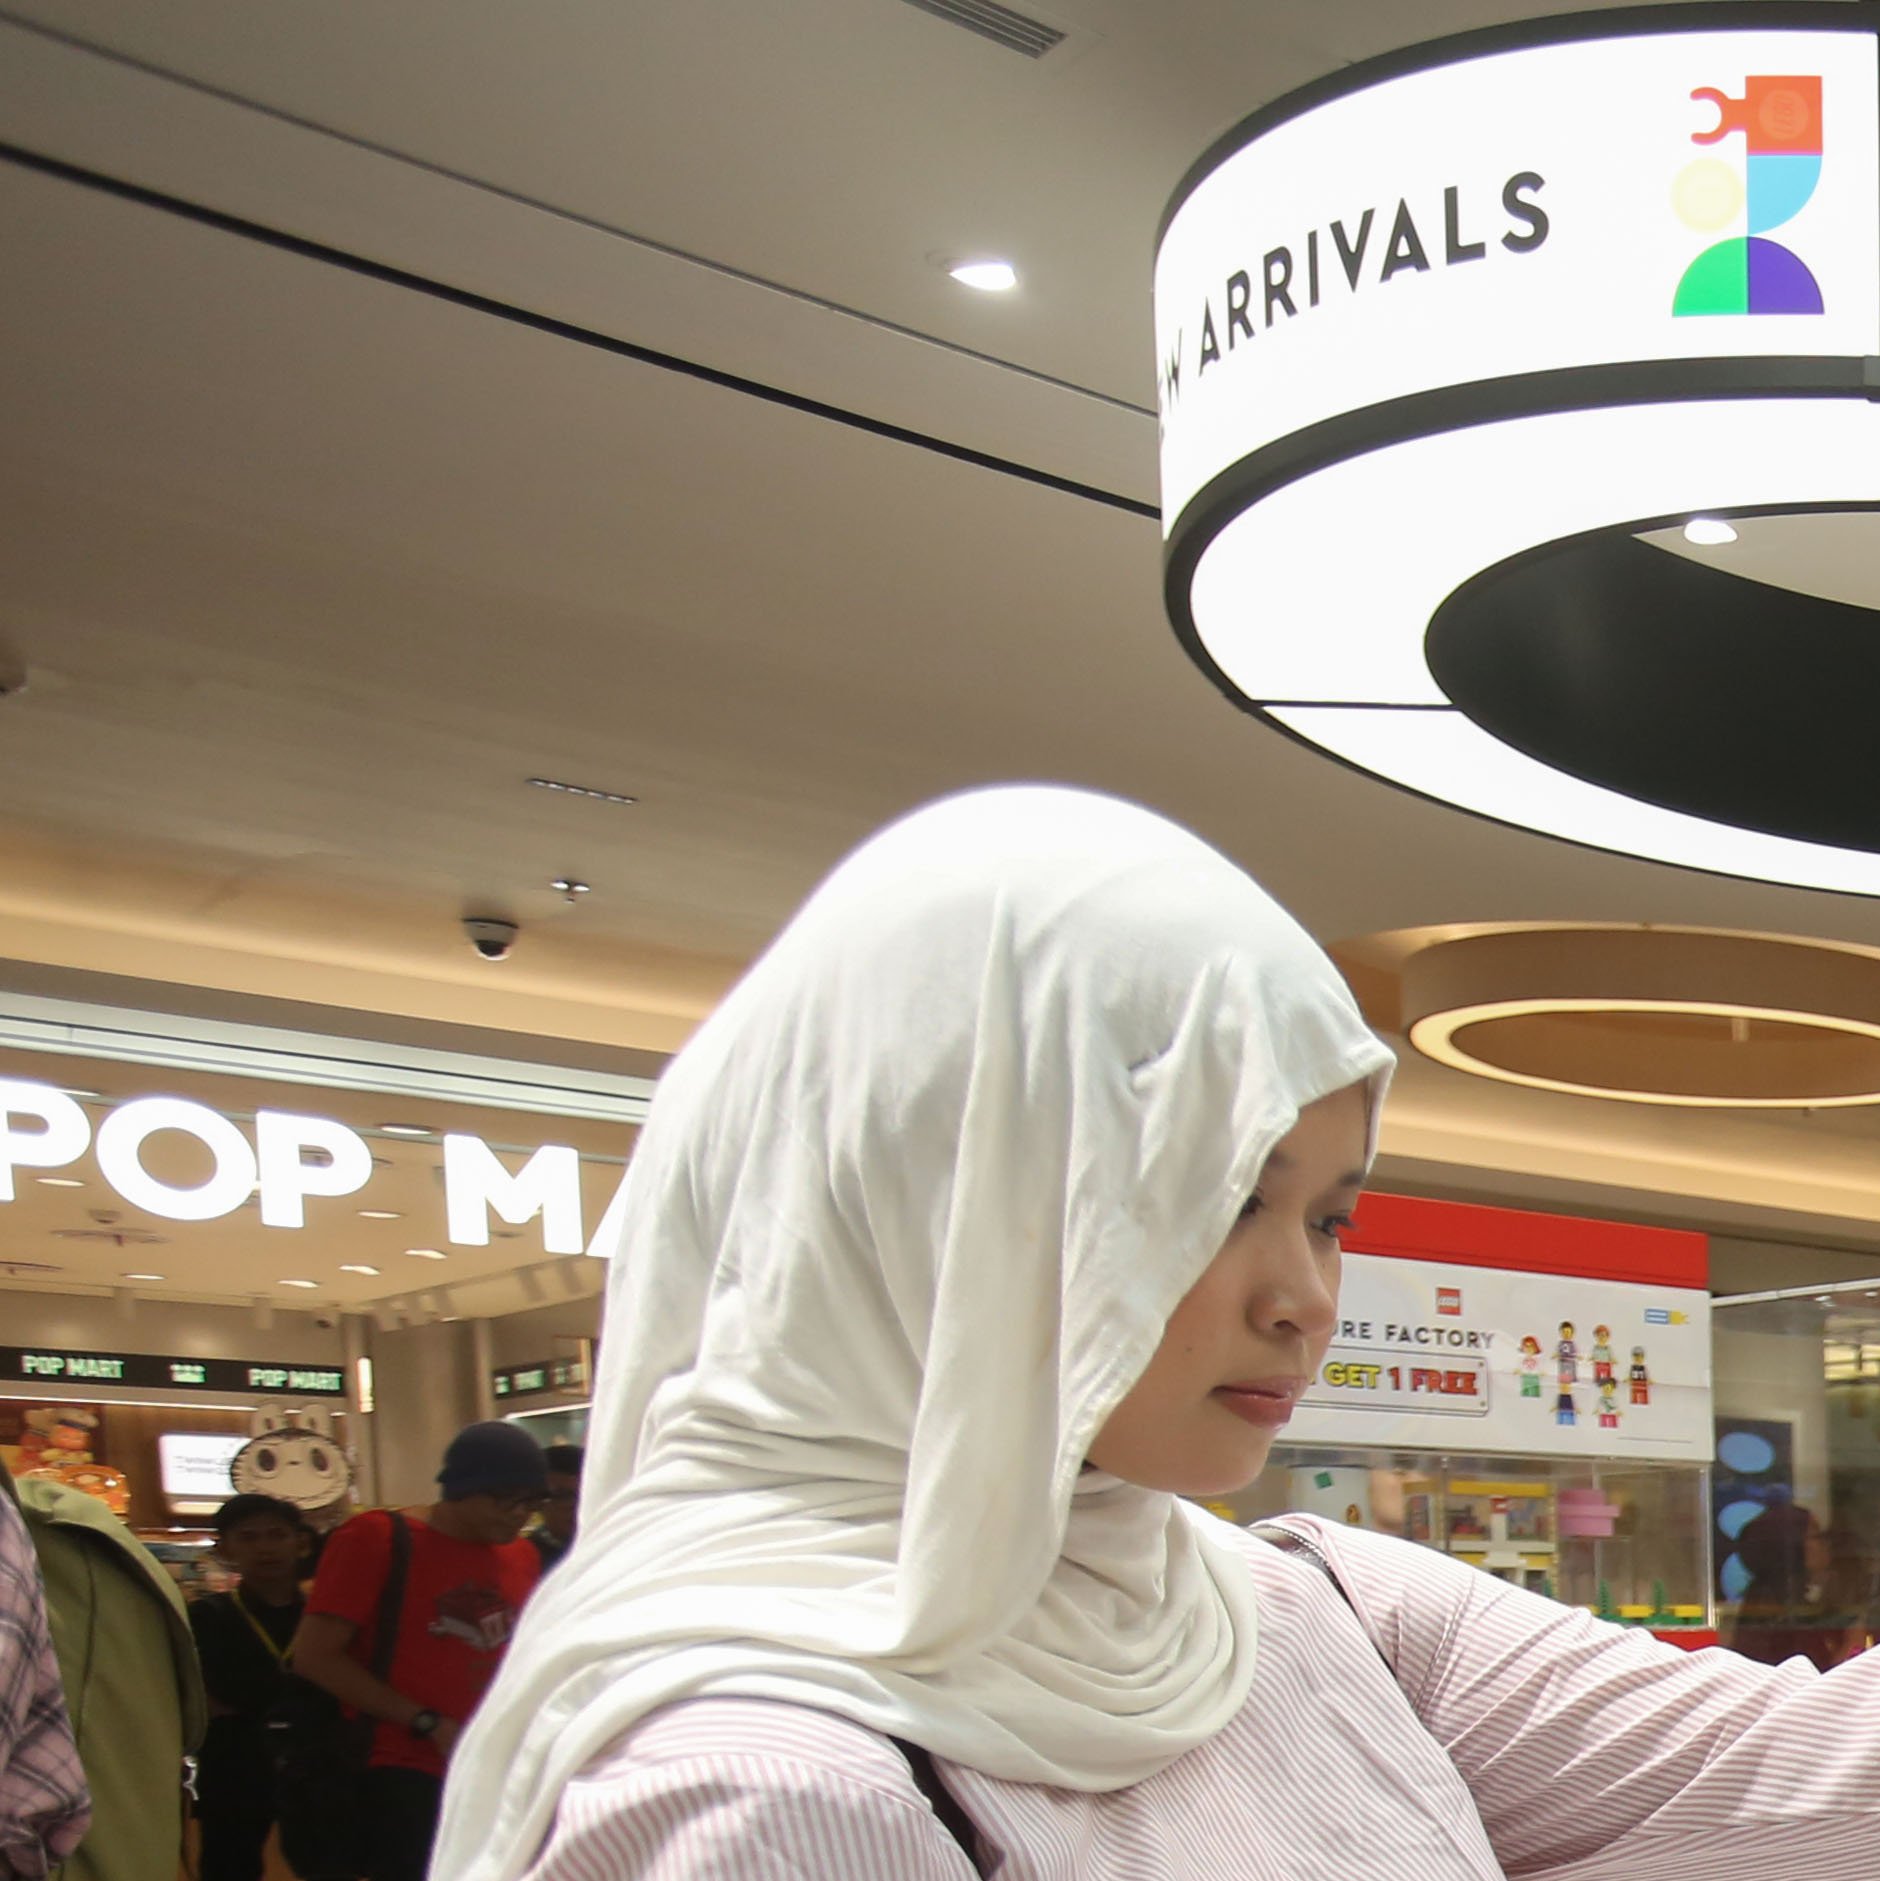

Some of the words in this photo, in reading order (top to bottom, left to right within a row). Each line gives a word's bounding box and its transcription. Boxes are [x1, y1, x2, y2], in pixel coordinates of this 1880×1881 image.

[1198, 171, 1551, 377] ARRIVALS
[0, 1080, 372, 1229] POP
[1385, 1324, 1495, 1349] FACTORY
[22, 1355, 64, 1376] POP
[66, 1357, 124, 1379] MART
[248, 1368, 288, 1388] POP
[1323, 1361, 1381, 1390] GET
[1387, 1366, 1401, 1391] 1
[1409, 1367, 1478, 1396] FREE
